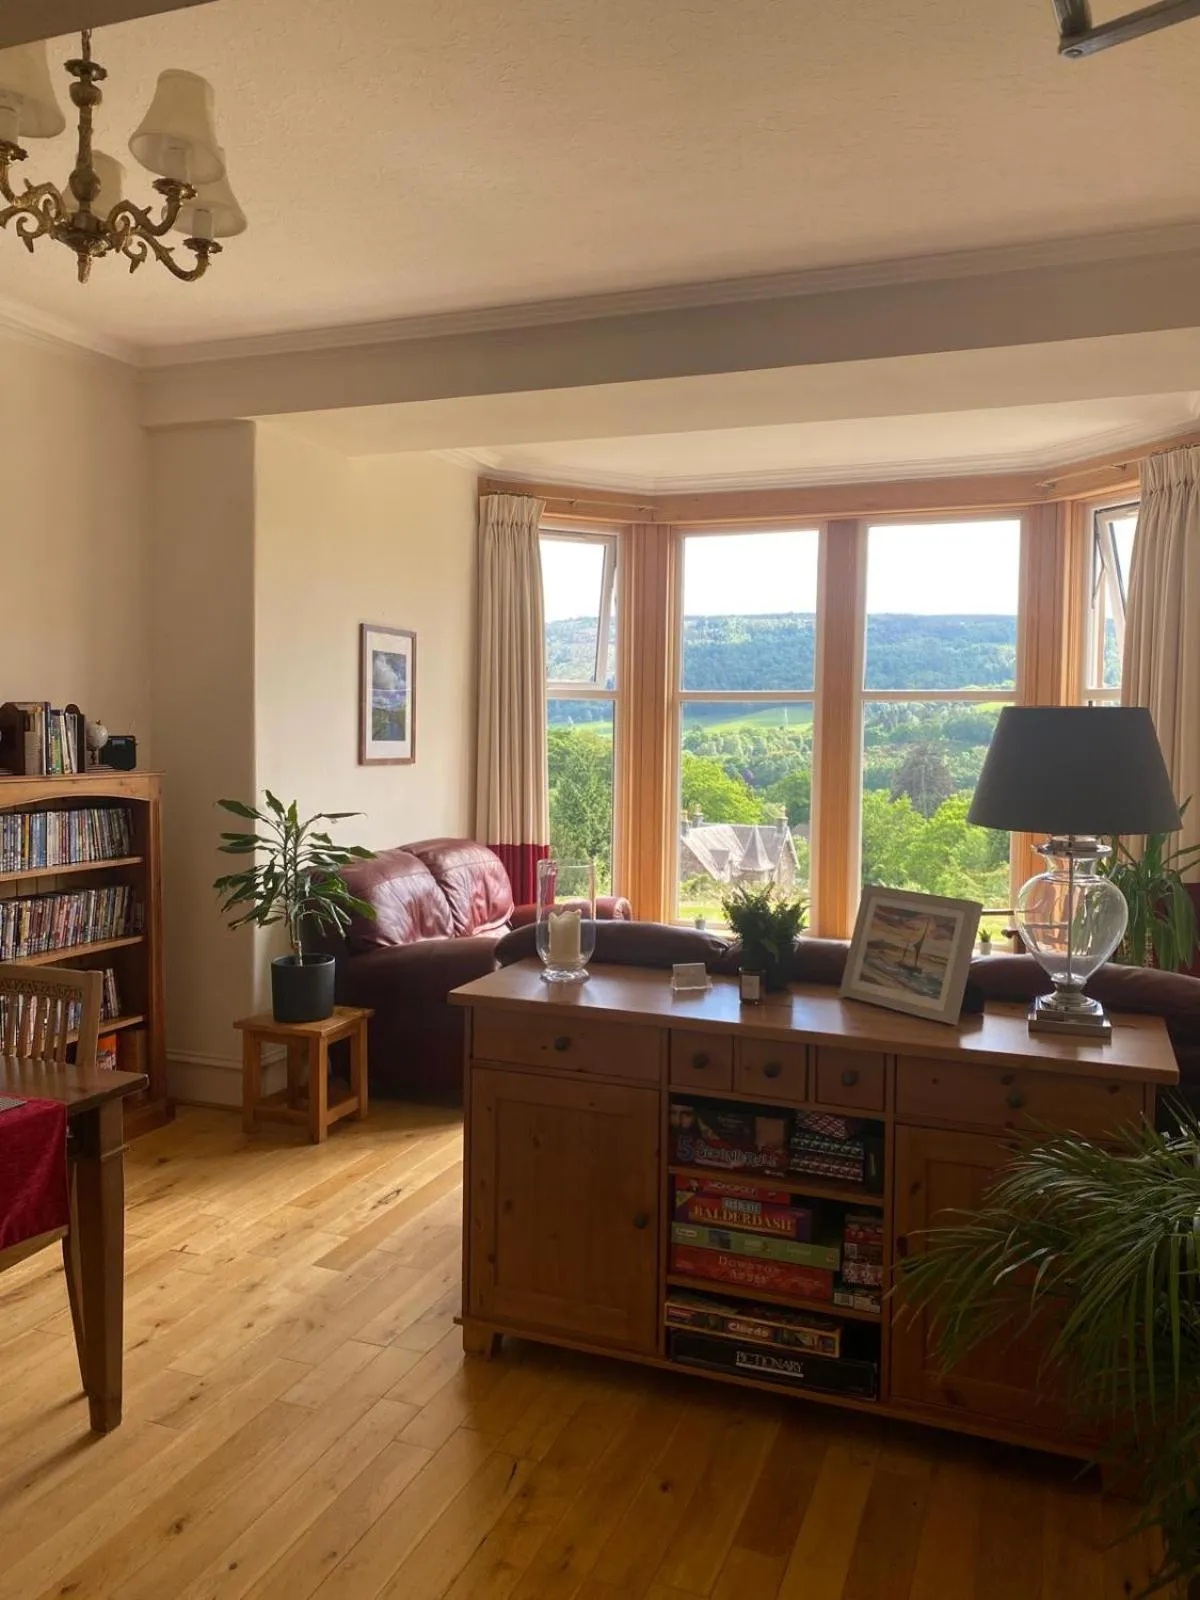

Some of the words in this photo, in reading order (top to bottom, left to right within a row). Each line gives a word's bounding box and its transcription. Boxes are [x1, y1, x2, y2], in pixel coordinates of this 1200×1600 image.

[693, 1205, 792, 1230] BALDERDASH
[728, 1322, 771, 1337] Cluedo
[735, 1350, 804, 1373] PICTIONARY
